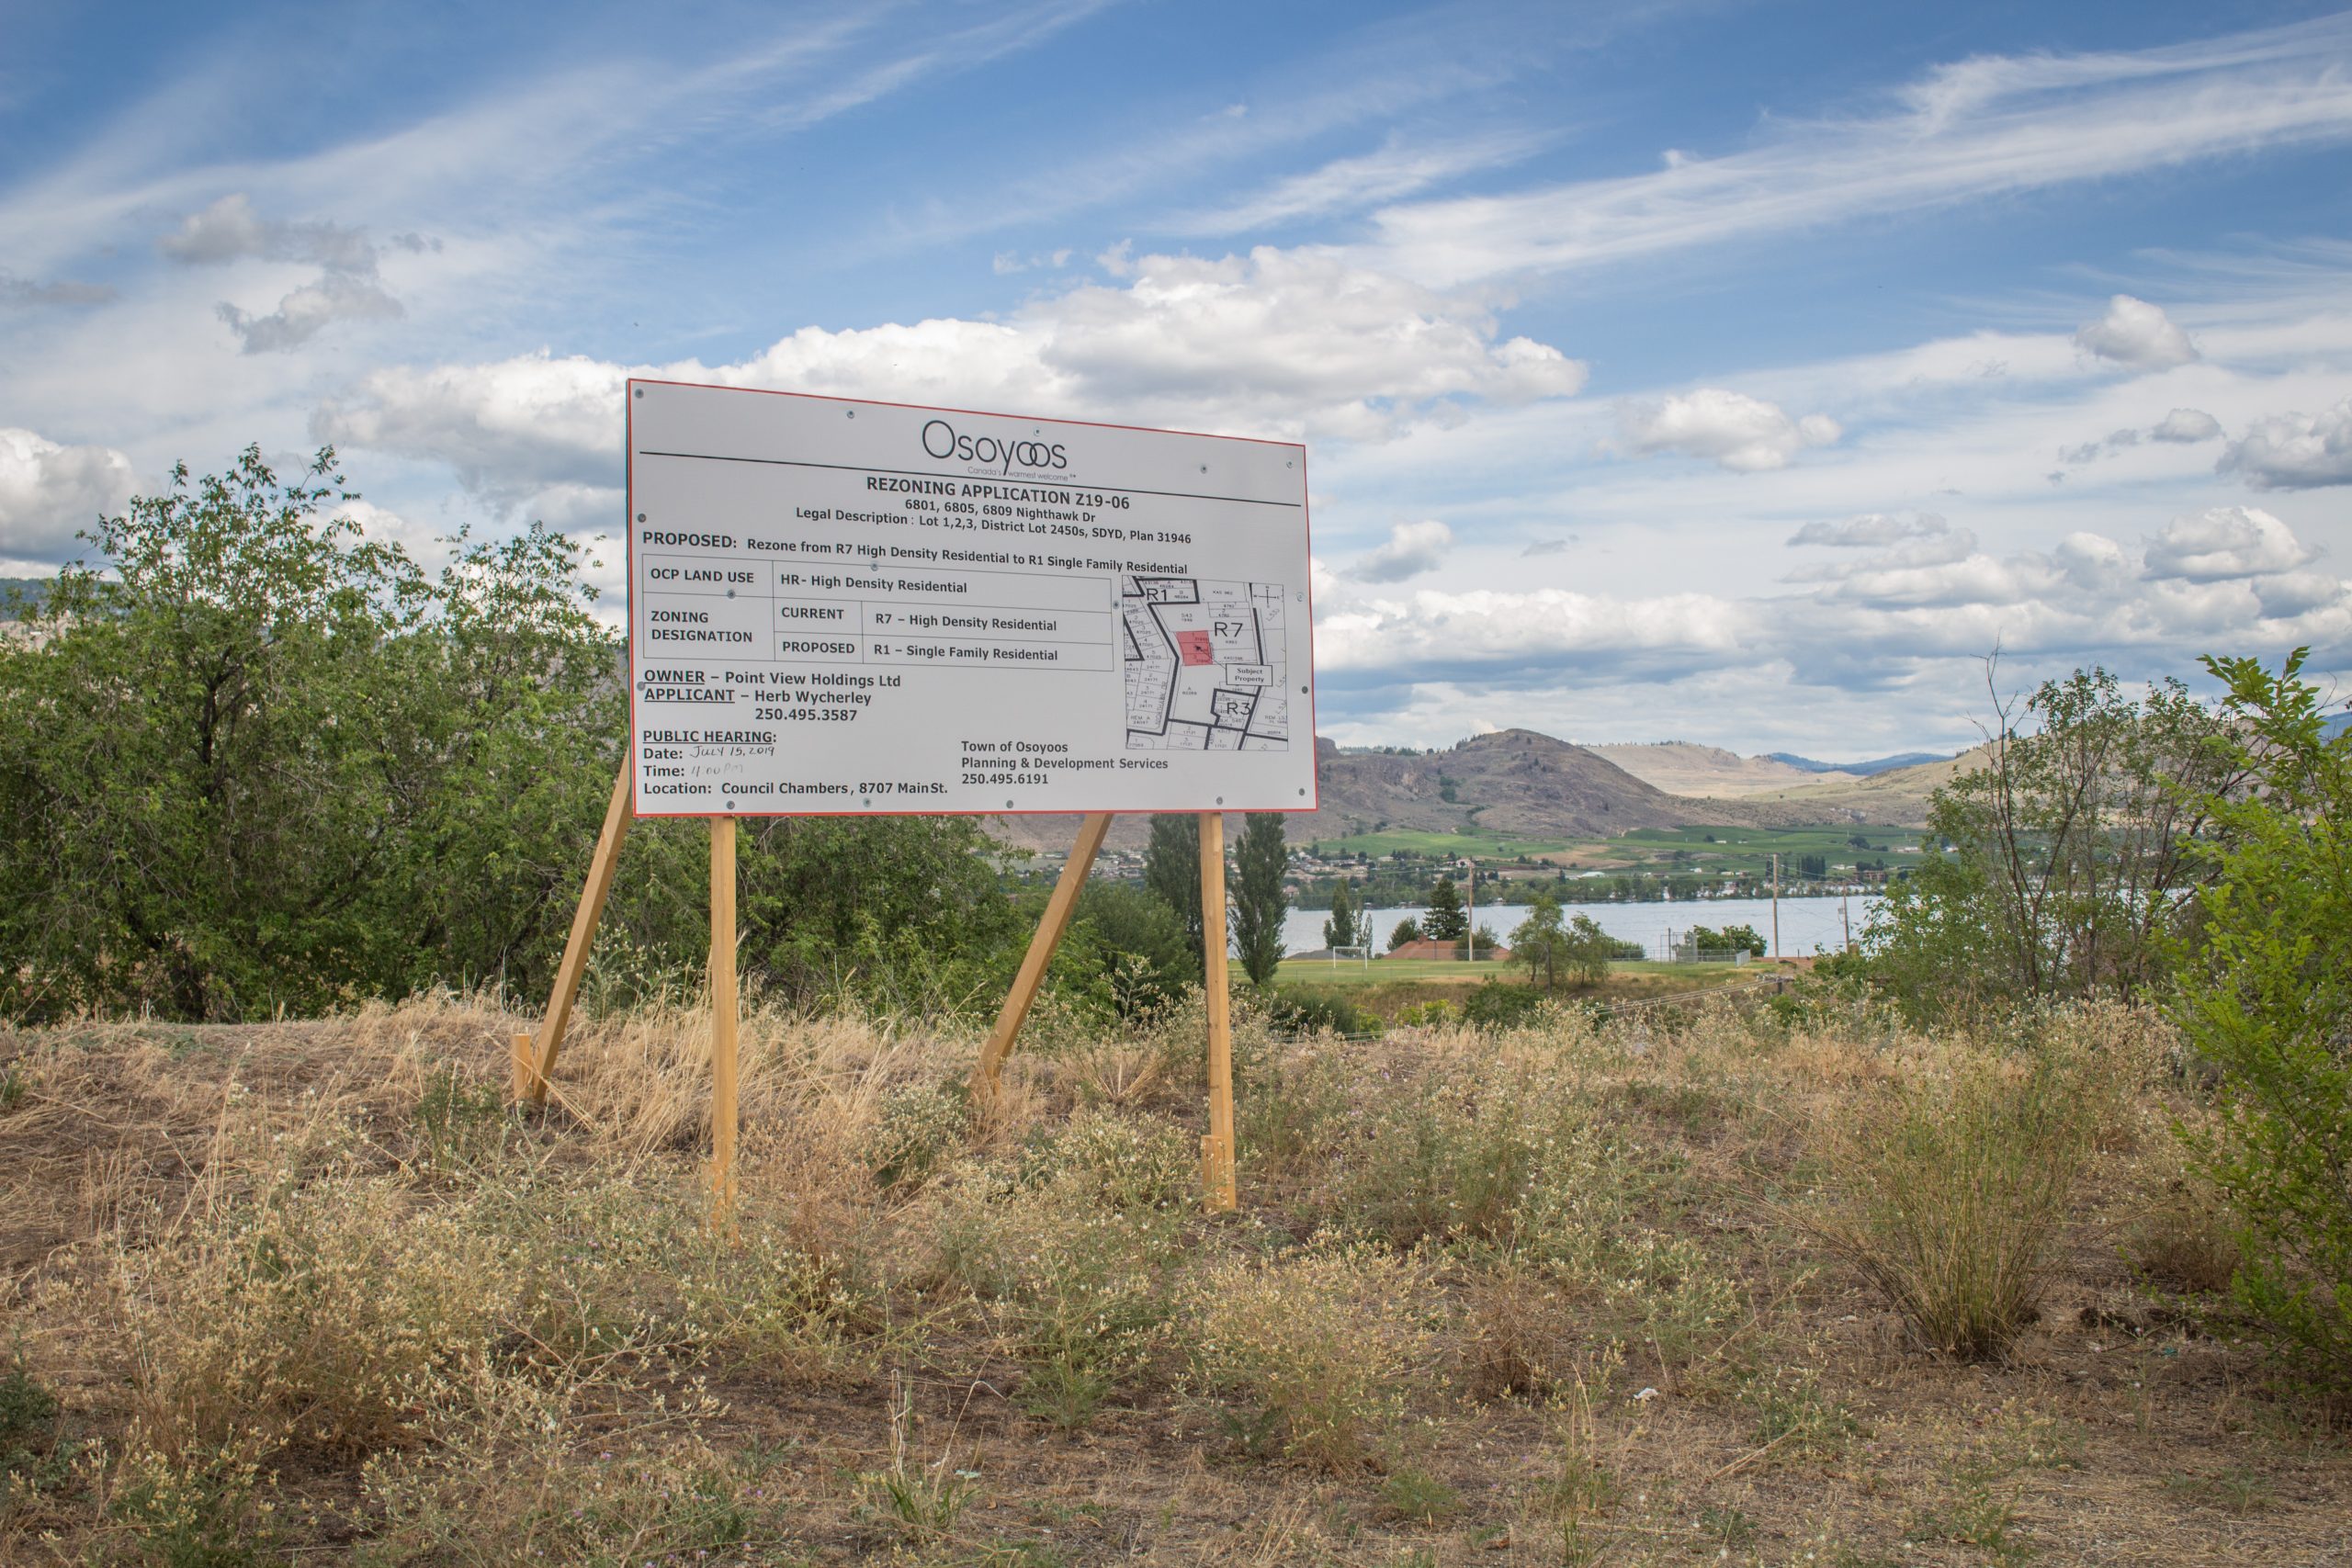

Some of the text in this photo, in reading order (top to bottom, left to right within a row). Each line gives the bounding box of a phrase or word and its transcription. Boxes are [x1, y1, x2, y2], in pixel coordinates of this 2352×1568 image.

[922, 420, 1067, 475] Osoyoos
[968, 467, 1001, 476] Canada's
[1037, 473, 1068, 481] welcome
[867, 476, 1130, 510] REZONING APPLICATION Z19-06
[905, 499, 1095, 523] 6801, 6805, 6809 Nighthawk Dr
[796, 507, 831, 521] Legal
[919, 516, 938, 527] Lot
[943, 517, 977, 530] 1,2,3,
[982, 519, 1025, 533] District
[1028, 522, 1047, 534] Lot
[1050, 524, 1088, 539] 2450s,
[1091, 528, 1127, 541] SDYD,
[1130, 530, 1153, 542] Plan
[1157, 533, 1191, 544] 31946
[643, 531, 1187, 574] PROPOSED: Rezone from R7 High Density Residential to R1 Single Family Residential
[650, 568, 754, 583] OCP LAND USE
[781, 574, 967, 592] HR- High Density Residential
[1147, 588, 1167, 601] R1
[651, 611, 709, 623] ZONING
[781, 607, 844, 620] CURRENT
[876, 613, 892, 624] R7
[909, 615, 938, 627] High
[942, 616, 988, 630] Density
[992, 618, 1057, 632] Residential
[1214, 622, 1243, 637] R7
[651, 629, 752, 642] DESIGNATION
[783, 641, 855, 654] PROPOSED
[874, 644, 890, 655] R1
[907, 645, 945, 658] Single
[949, 647, 989, 662] Family
[993, 648, 1058, 661] Residential
[644, 670, 705, 682] OWNER
[725, 671, 765, 684] Point
[770, 672, 806, 685] View
[811, 673, 874, 688] Holdings
[879, 675, 901, 687] Ltd
[644, 689, 735, 701] APPLICANT
[754, 690, 791, 702] Herb
[795, 690, 871, 706] Wycherley
[755, 708, 857, 721] 250.495.3587
[1227, 703, 1251, 714] R3
[643, 730, 777, 743] PUBLIC HEARING:
[644, 747, 683, 759] Date:
[749, 746, 774, 756] 2019
[962, 741, 1068, 755] Town of Osoyoos
[644, 766, 685, 777] Time:
[962, 758, 1168, 772] Planning & Development Services
[962, 773, 1048, 784] 250.495.6191
[644, 783, 711, 794] Location:
[722, 783, 774, 794] Council
[859, 783, 893, 793] 8707
[897, 783, 928, 794] Main
[931, 783, 948, 794] St.
